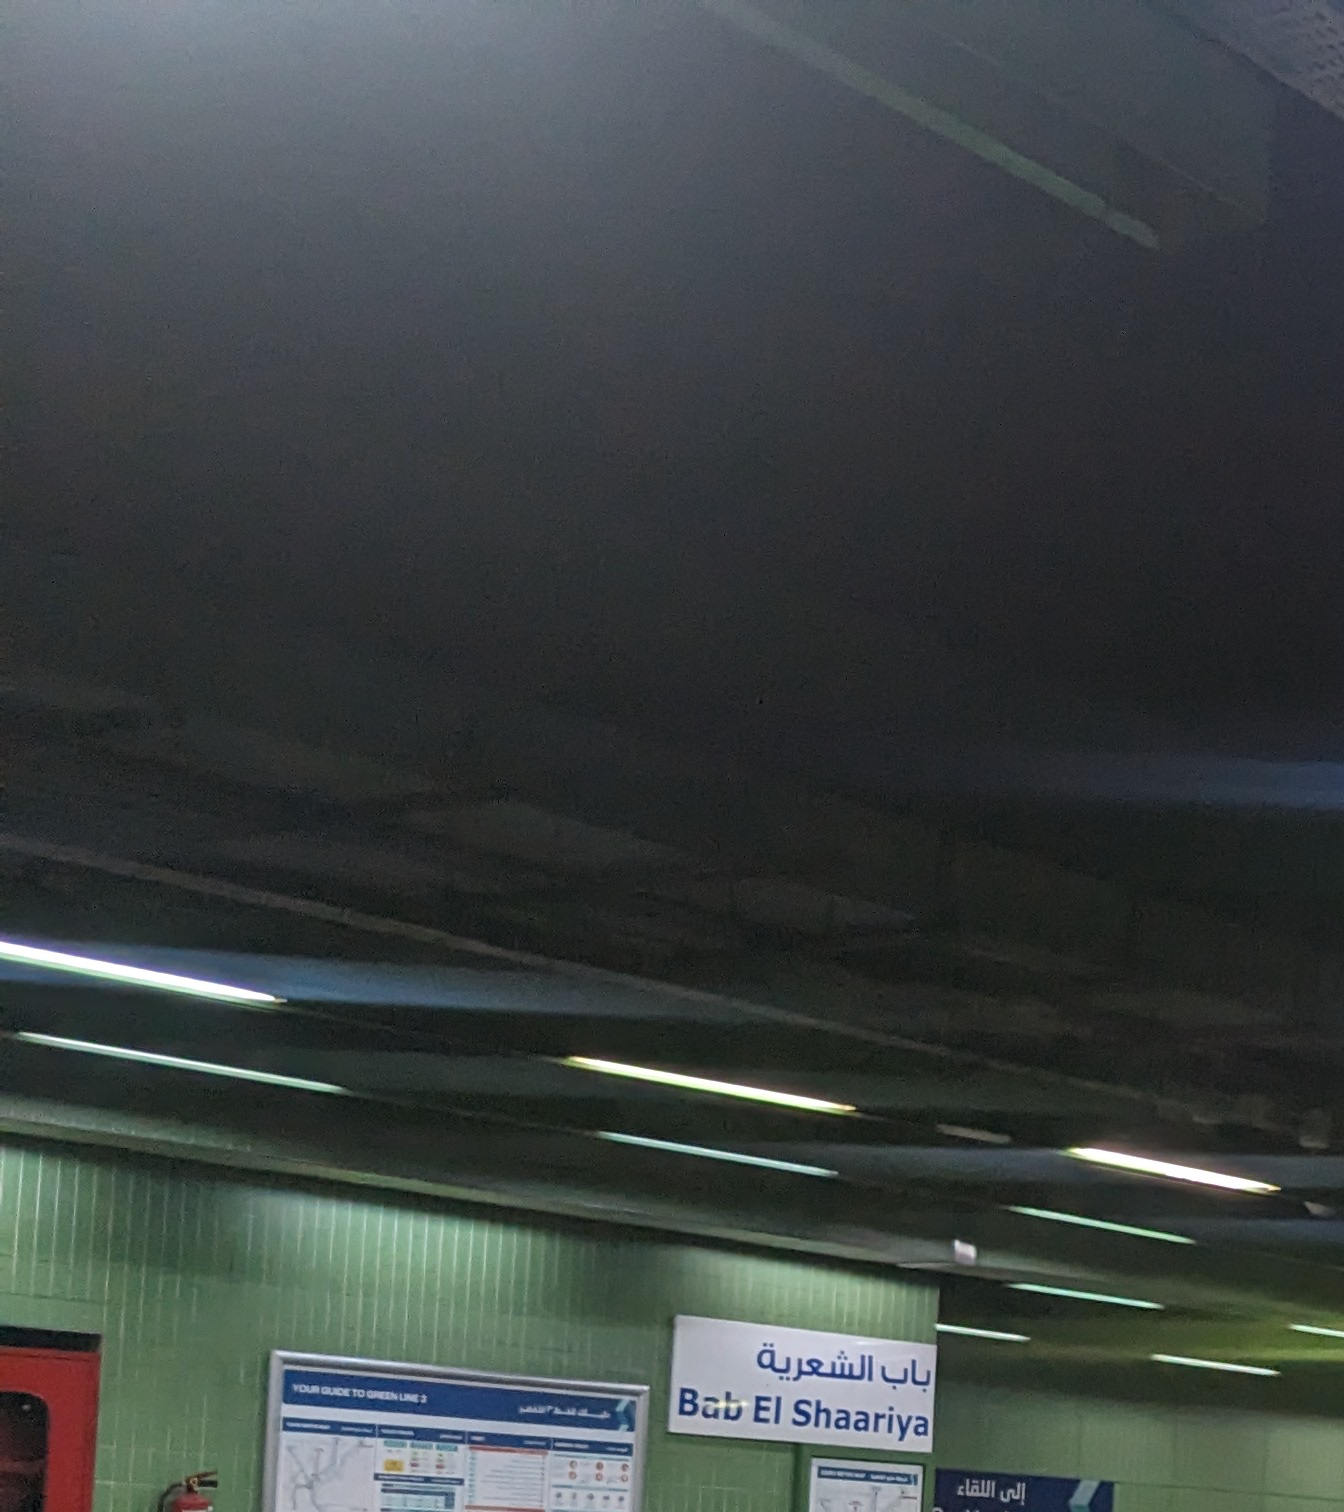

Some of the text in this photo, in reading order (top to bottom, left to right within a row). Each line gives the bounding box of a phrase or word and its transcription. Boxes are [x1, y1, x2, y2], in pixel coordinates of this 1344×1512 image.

[756, 1342, 932, 1393] باب الشعرية
[678, 1387, 930, 1442] Bab El Shaariya
[957, 1478, 1027, 1506] إلى اللقاء
